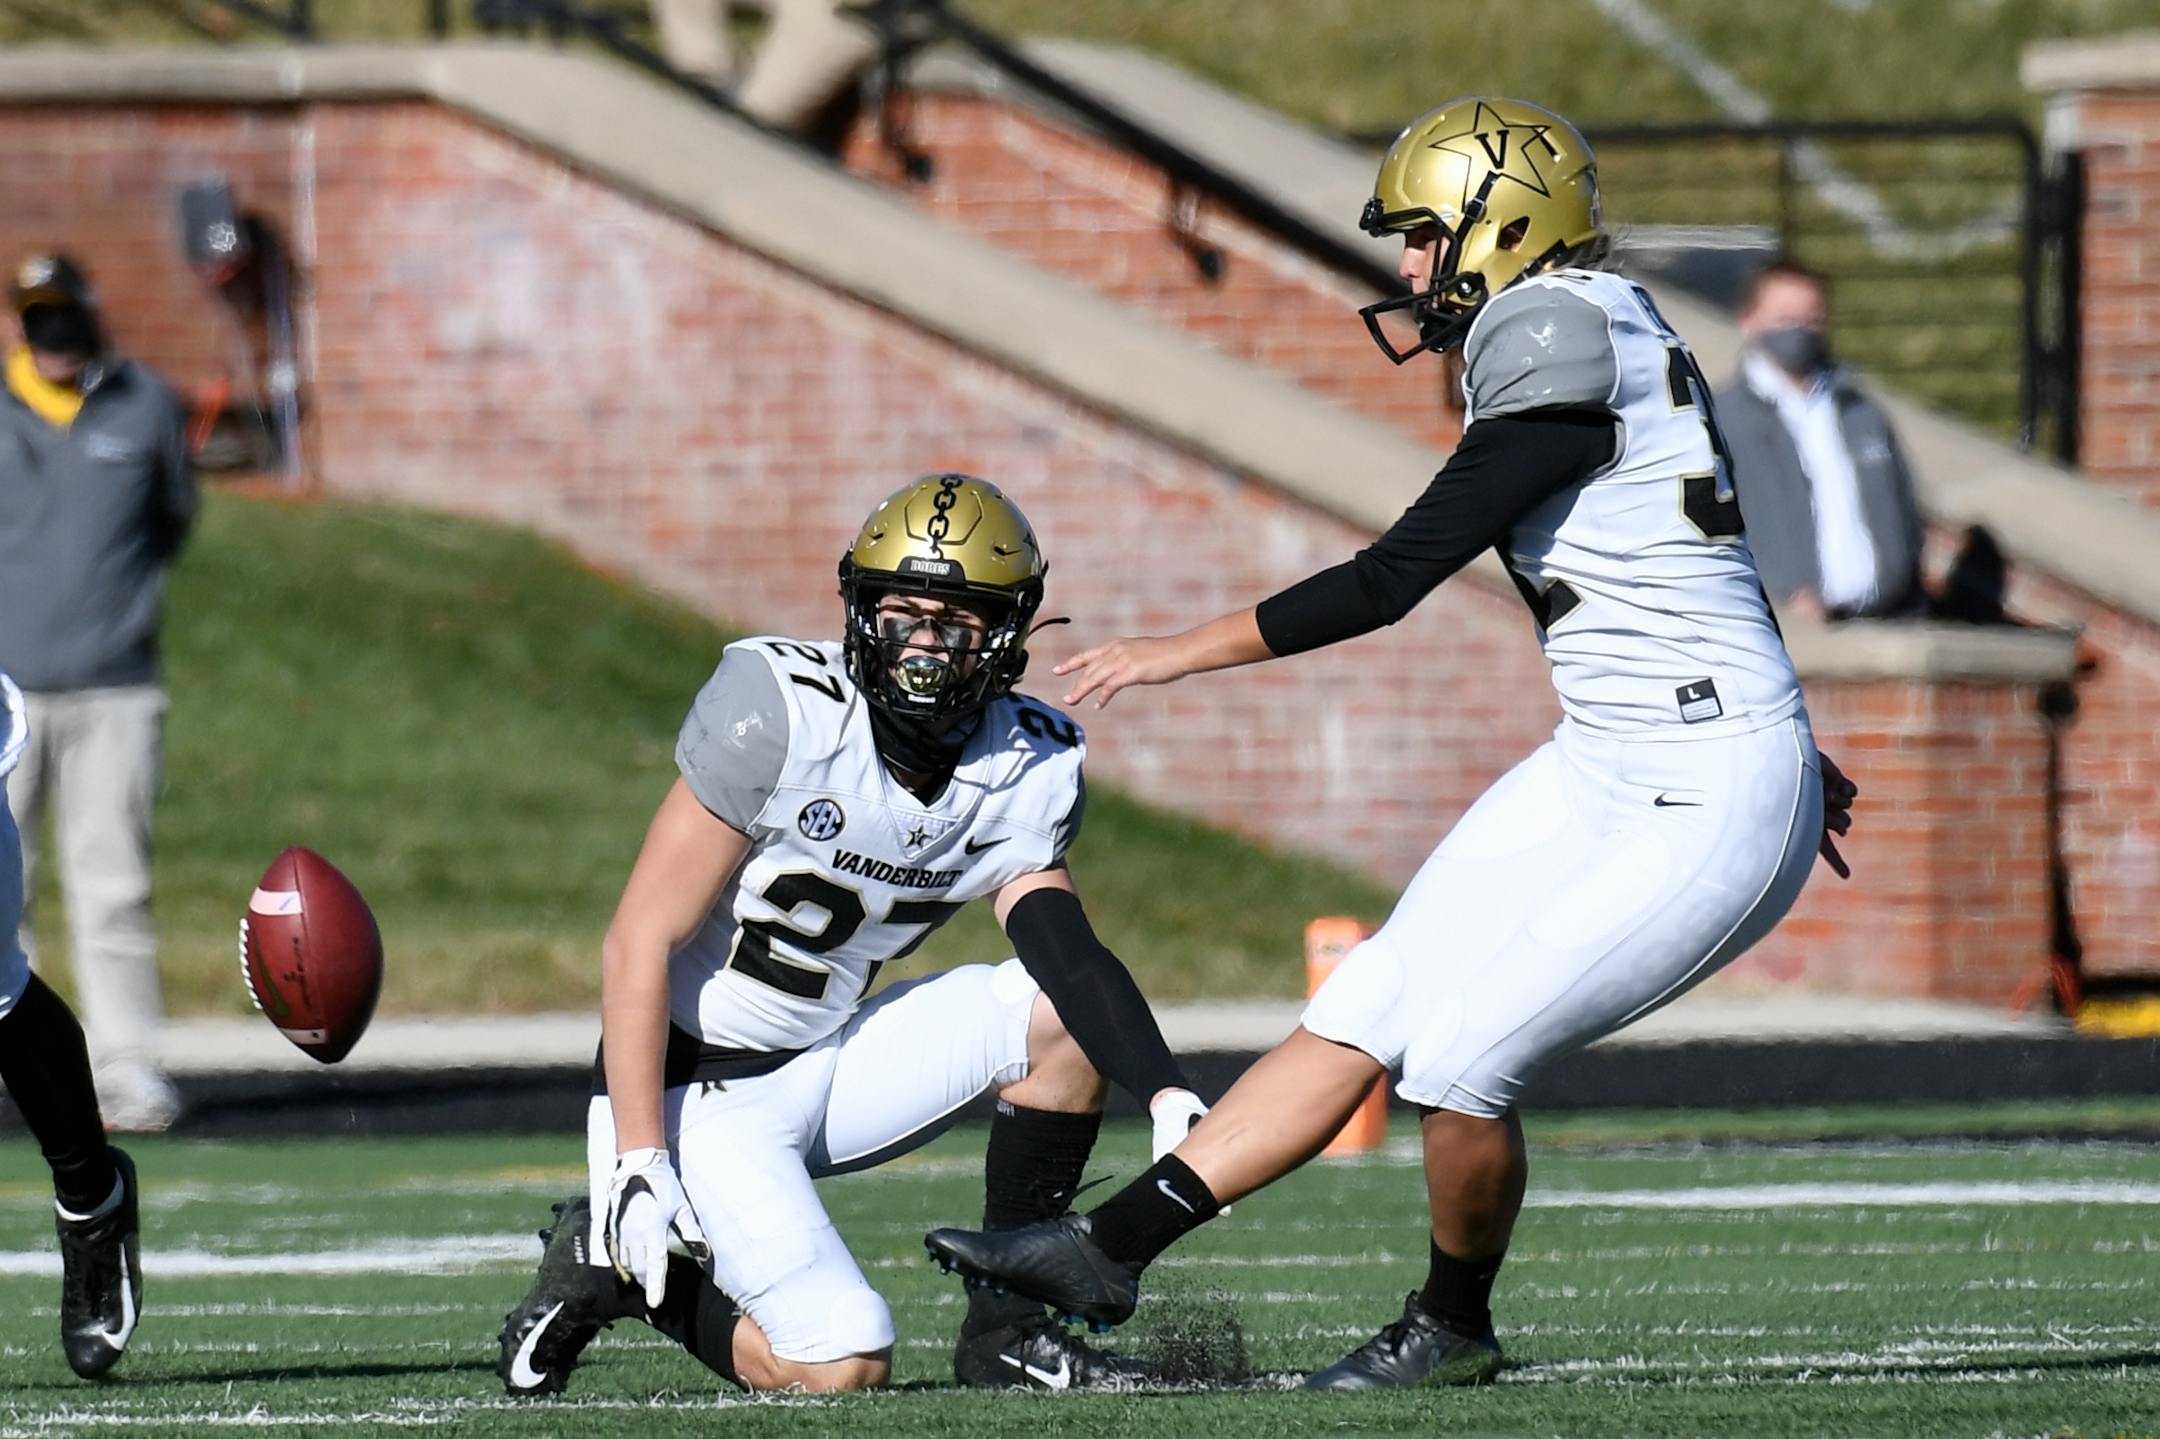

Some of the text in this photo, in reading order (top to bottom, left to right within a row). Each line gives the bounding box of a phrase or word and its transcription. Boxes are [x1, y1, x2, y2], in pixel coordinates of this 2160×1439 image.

[1475, 129, 1509, 169] V
[763, 642, 847, 703] 27
[1687, 686, 1701, 700] L
[800, 801, 843, 840] SEC
[832, 849, 963, 889] VANDERBILT
[729, 869, 965, 1000] 27
